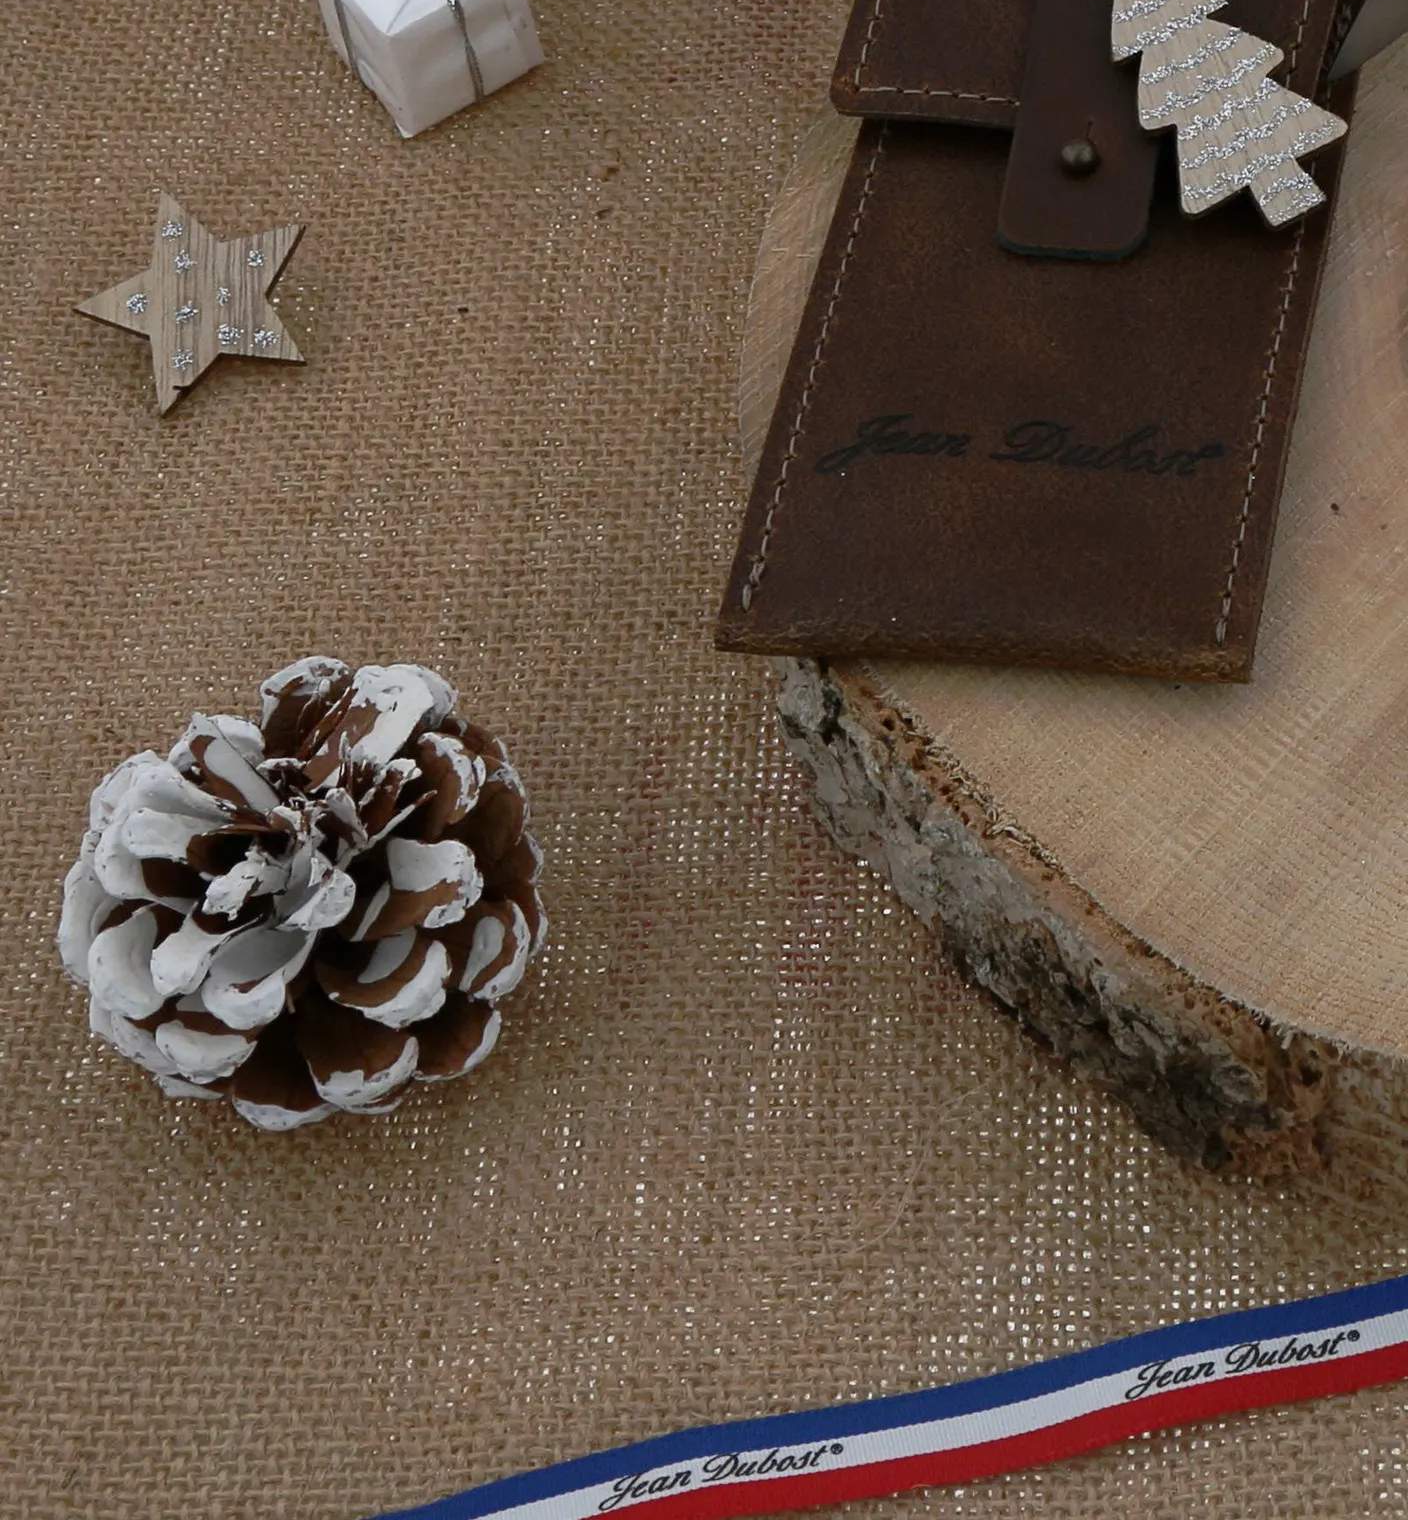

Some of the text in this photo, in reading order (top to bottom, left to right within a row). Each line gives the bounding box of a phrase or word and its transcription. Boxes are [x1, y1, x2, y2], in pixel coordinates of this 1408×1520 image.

[814, 413, 971, 473] Jean
[1124, 1359, 1216, 1400] Jean
[598, 1468, 692, 1512] Jean
